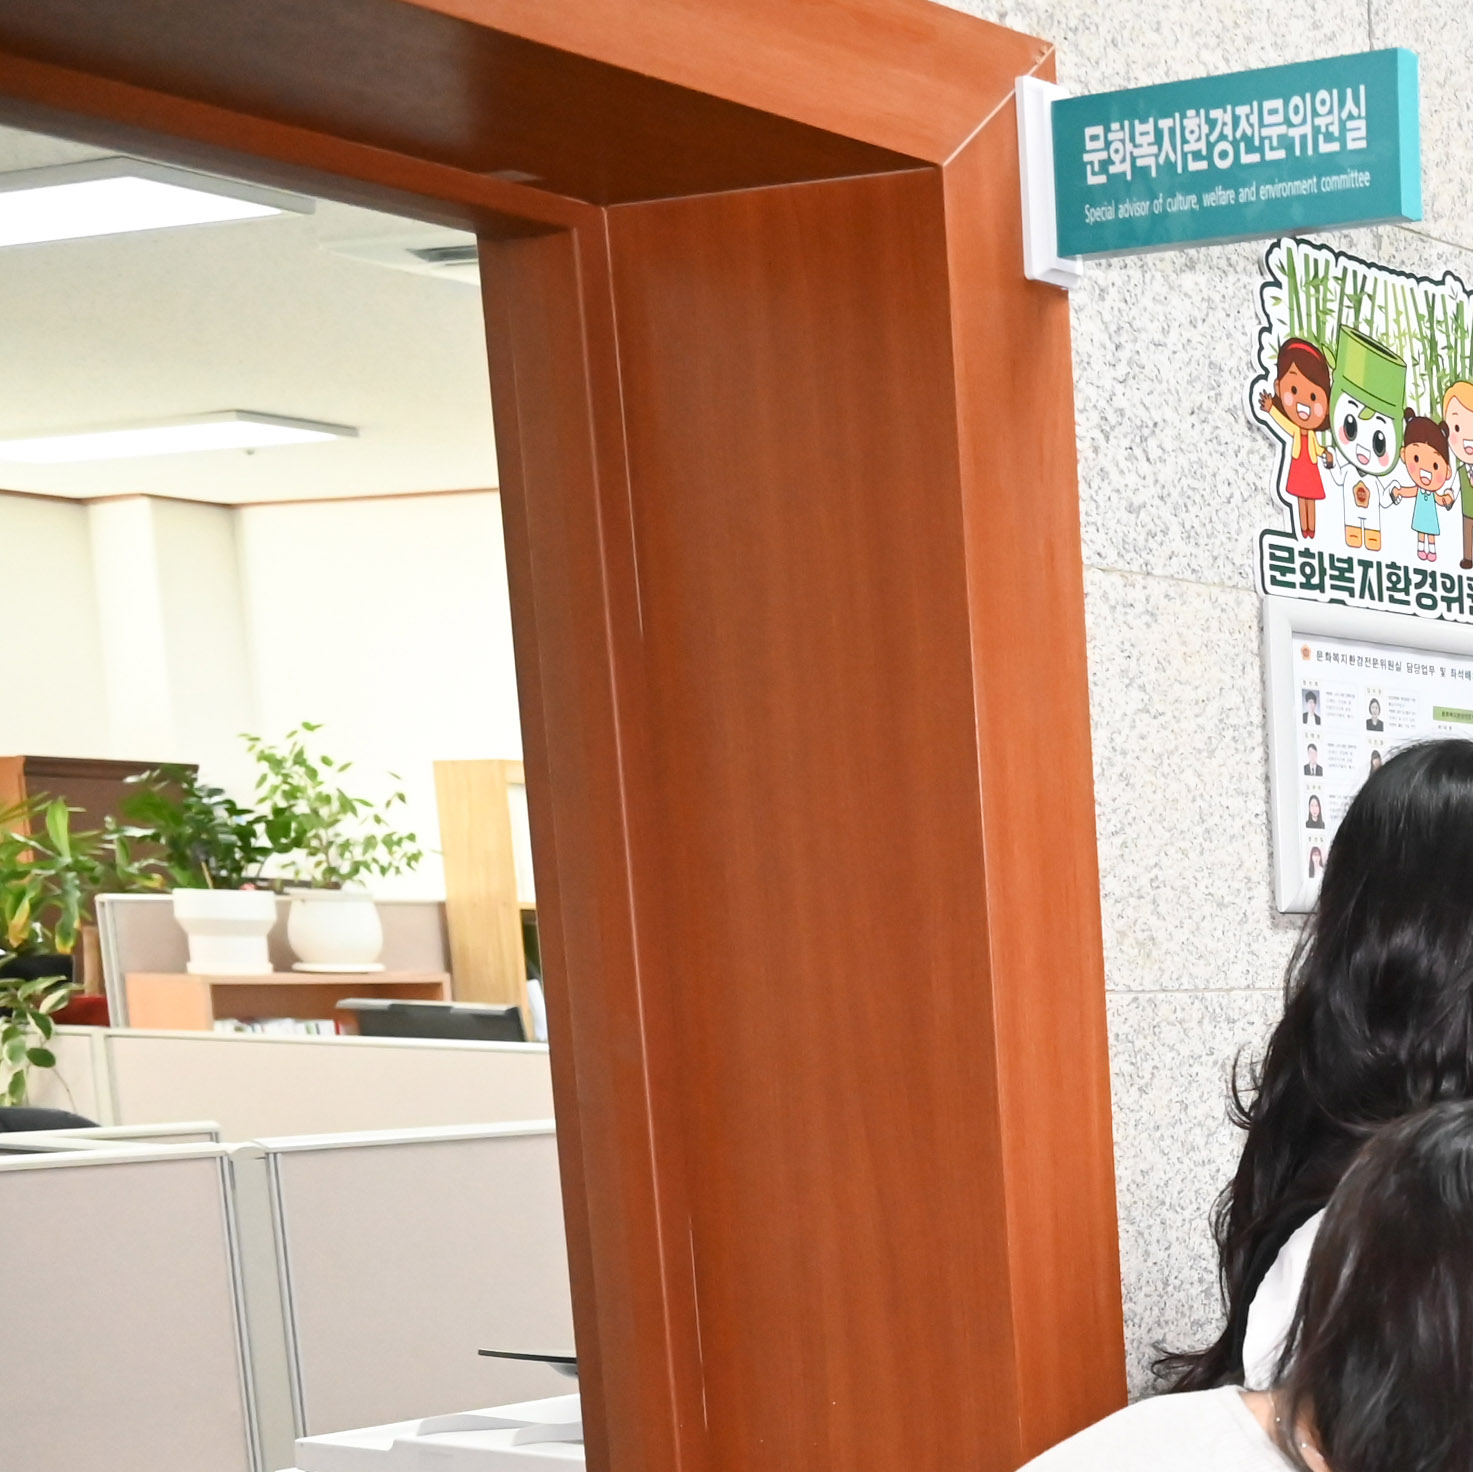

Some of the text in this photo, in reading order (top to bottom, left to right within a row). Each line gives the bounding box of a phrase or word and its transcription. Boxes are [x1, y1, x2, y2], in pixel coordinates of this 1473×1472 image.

[1083, 84, 1367, 185] 문화복지환경전문위원실
[1084, 168, 1371, 225] Special advisor of culture, welfare and environment committee
